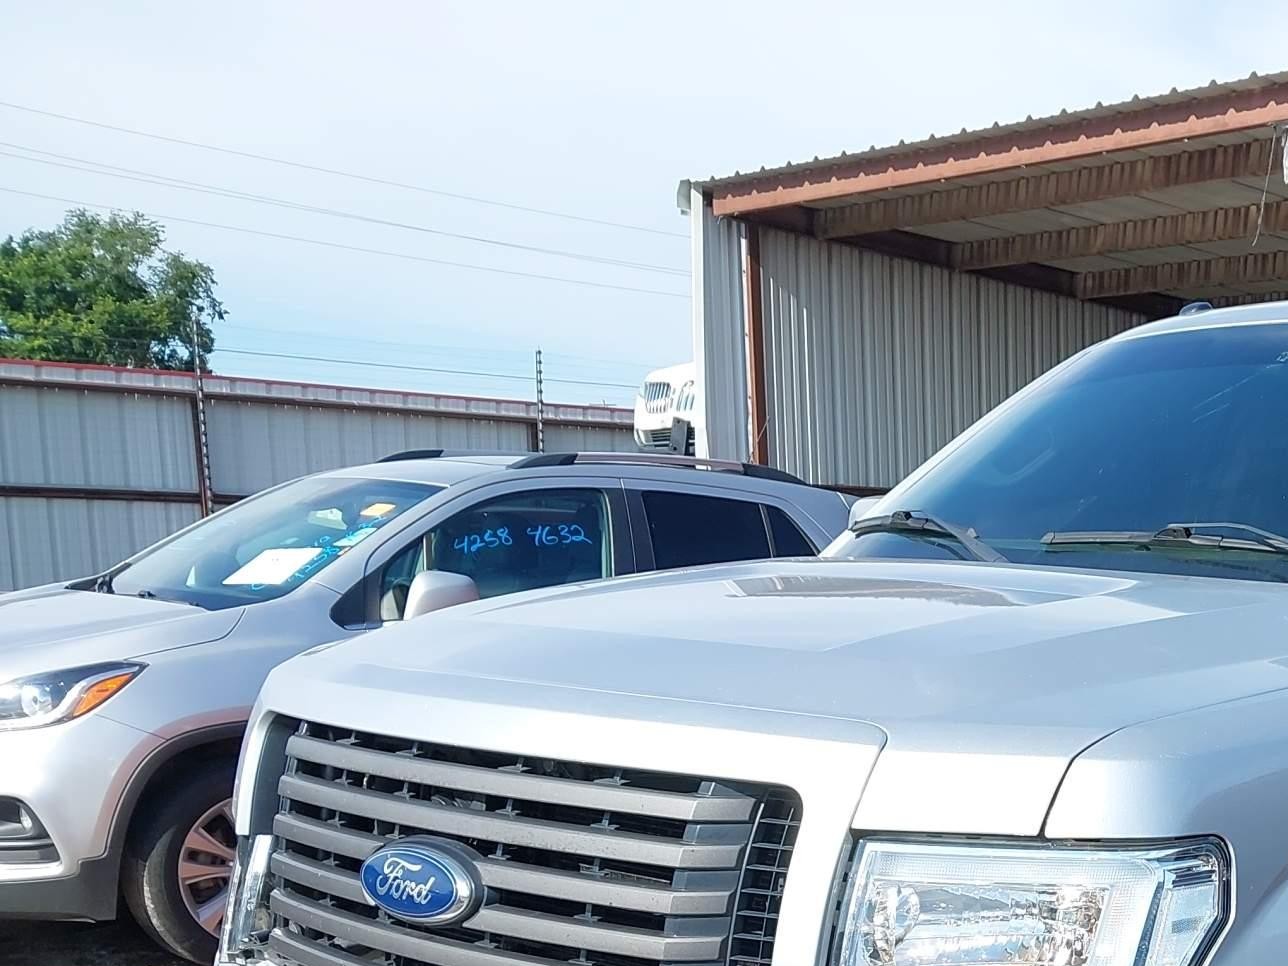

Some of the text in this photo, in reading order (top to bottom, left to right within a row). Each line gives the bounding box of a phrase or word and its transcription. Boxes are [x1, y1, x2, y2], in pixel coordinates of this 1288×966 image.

[453, 524, 593, 555] 4258 4632
[375, 856, 436, 905] Ford
